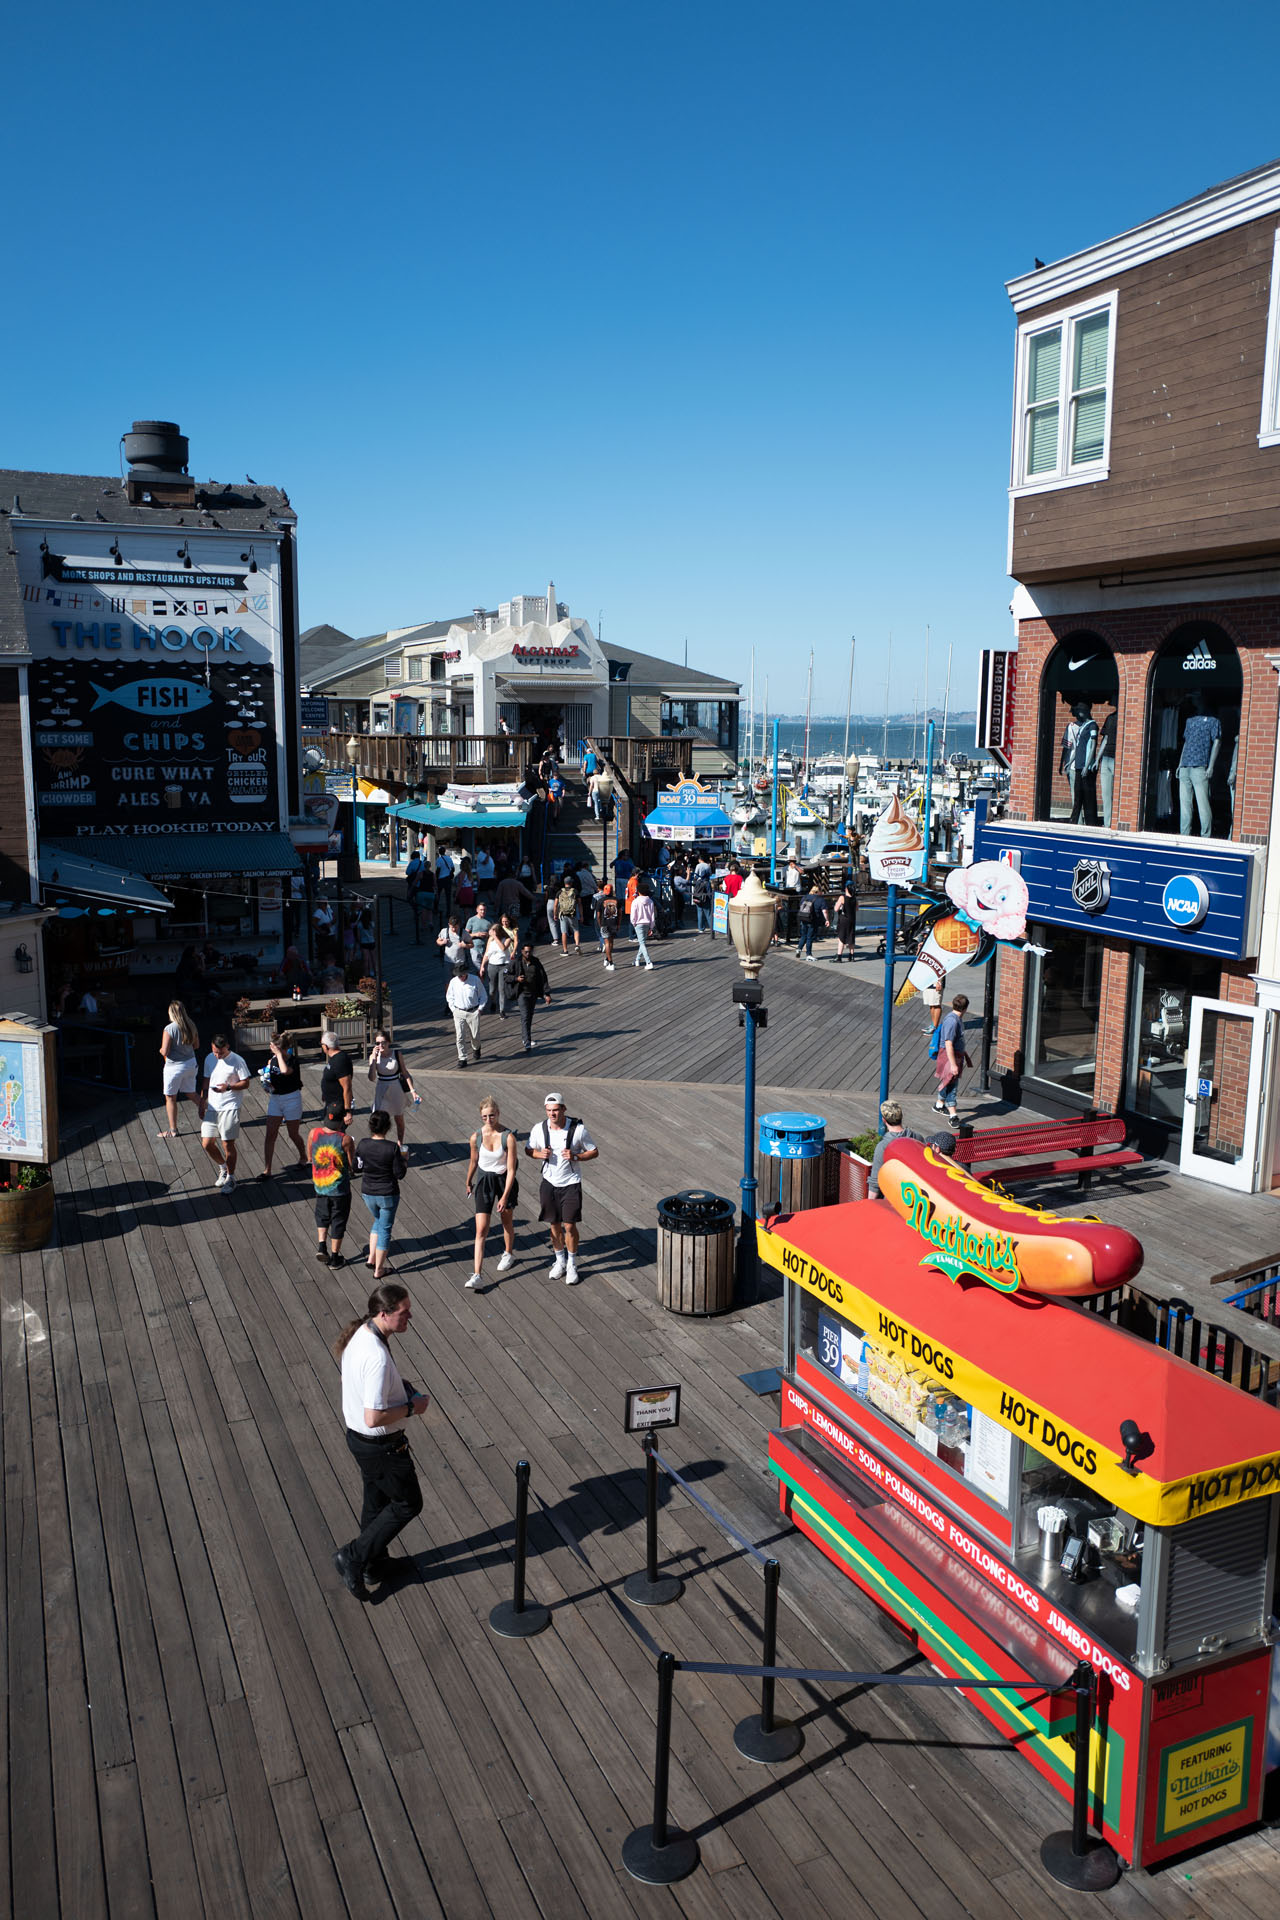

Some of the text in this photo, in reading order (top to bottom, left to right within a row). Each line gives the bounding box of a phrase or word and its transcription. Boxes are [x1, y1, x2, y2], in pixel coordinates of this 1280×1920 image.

[61, 570, 236, 586] MORE SHOPS AND RESTAURANTS UPSTAIRS
[52, 621, 243, 652] THE HOOK
[512, 643, 579, 657] ALCATRAZ
[1182, 659, 1217, 670] adidas
[138, 686, 188, 708] FISH
[992, 655, 1004, 742] EMBROIDERY
[150, 716, 183, 729] and
[40, 734, 90, 745] GET SOME
[123, 732, 206, 751] CHIPS
[111, 767, 215, 781] CURE WHAT
[227, 777, 268, 786] CHICKEN
[41, 793, 94, 804] CHOWDER
[117, 792, 212, 807] ALES YA
[660, 795, 681, 804] BOAT
[681, 794, 696, 806] 39
[75, 821, 276, 836] PLAY HOOKIE TODAY
[882, 856, 910, 867] Dreyer's
[1078, 876, 1097, 897] NHL
[1167, 897, 1200, 915] NCAA
[919, 953, 945, 976] Dreyer's
[901, 1181, 1018, 1271] Nathan's
[935, 1254, 964, 1270] FAMOUS
[782, 1247, 844, 1304] HOT DOGS
[823, 1325, 839, 1347] PIER
[878, 1312, 908, 1349] HOT
[911, 1335, 955, 1380] DOGS
[821, 1338, 840, 1368] 39
[999, 1390, 1040, 1435] HOT
[1041, 1418, 1097, 1475] DOGS
[1188, 1469, 1239, 1512] HOT
[787, 1389, 809, 1415] CHIPS
[811, 1409, 855, 1456] LEMONADE
[858, 1449, 882, 1480] SODA
[885, 1470, 918, 1510] POLISH
[917, 1500, 945, 1533] DOGS
[949, 1525, 1006, 1585] FOOTLONG
[1006, 1573, 1040, 1612] DOGS
[1047, 1610, 1091, 1656] JUMBO
[1092, 1646, 1131, 1691] DOGS
[1156, 1673, 1200, 1703] WIPEOUT
[1180, 1742, 1232, 1770] FEATURING
[1171, 1759, 1240, 1794] Nathan's
[1180, 1799, 1201, 1817] HOT
[1201, 1788, 1228, 1807] DOGS
